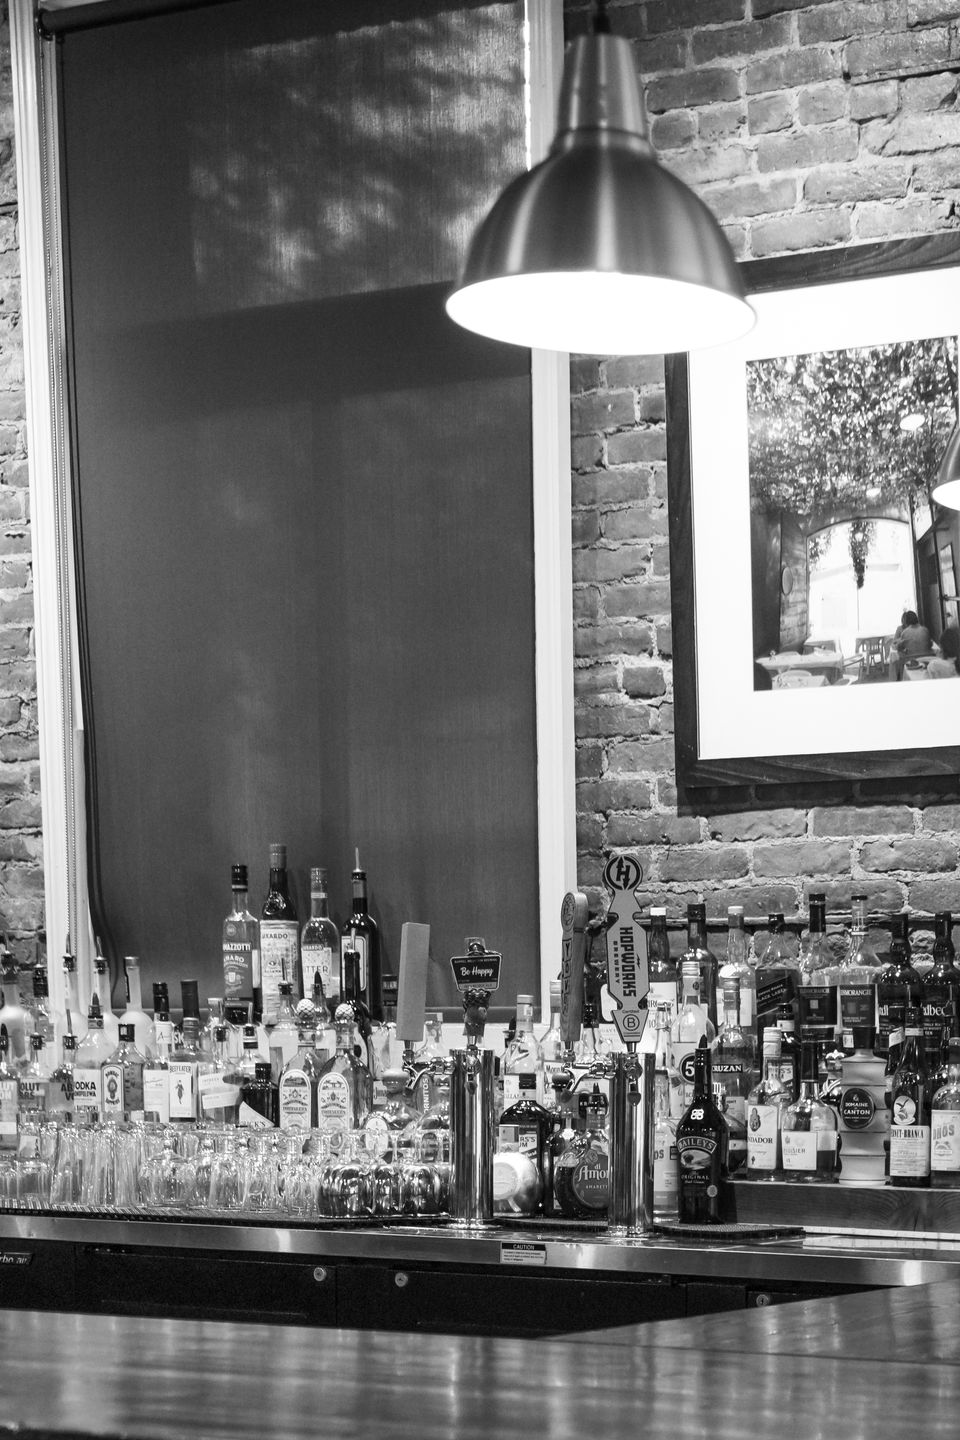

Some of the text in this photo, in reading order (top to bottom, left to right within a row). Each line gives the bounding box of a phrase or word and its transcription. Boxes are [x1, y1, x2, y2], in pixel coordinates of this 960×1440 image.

[460, 966, 494, 977] Be Happy
[613, 940, 621, 984] BREWERY
[619, 926, 637, 998] HOPWORKS
[679, 1137, 713, 1151] BAILEYS
